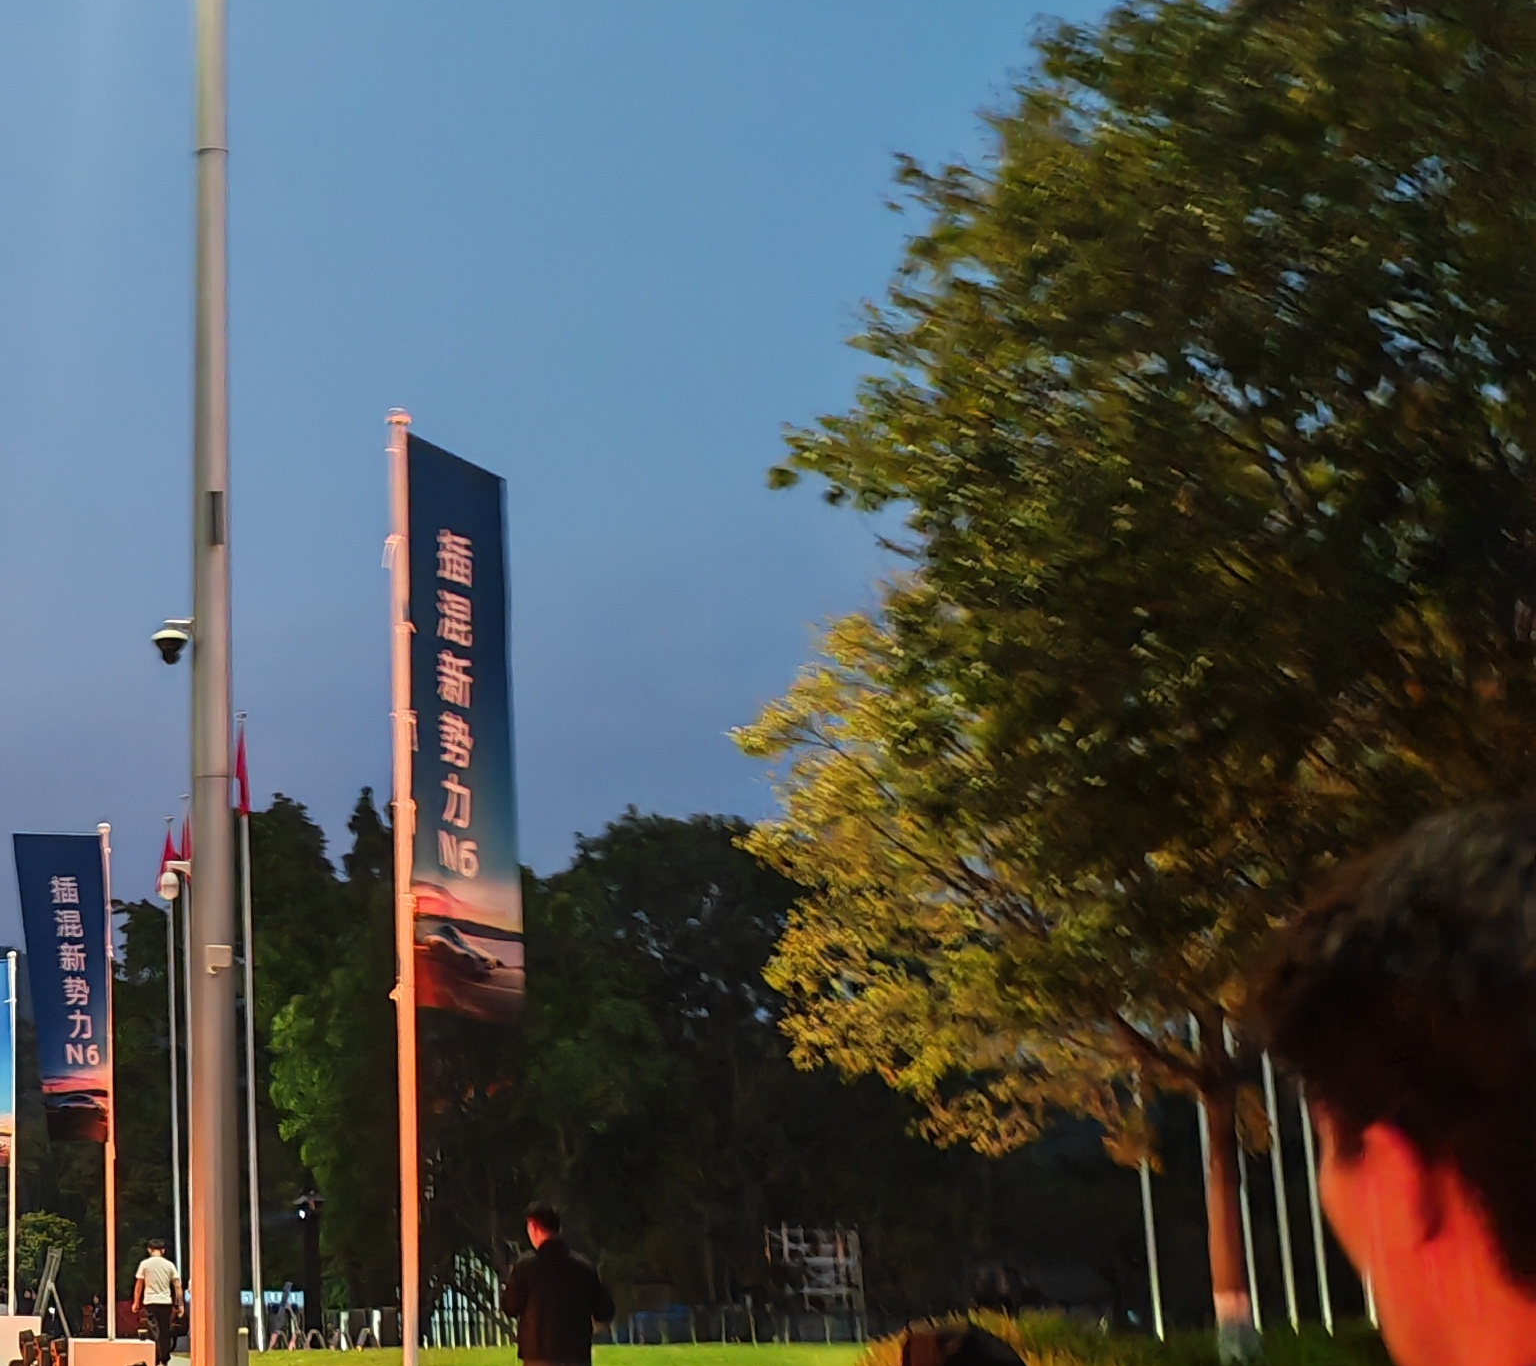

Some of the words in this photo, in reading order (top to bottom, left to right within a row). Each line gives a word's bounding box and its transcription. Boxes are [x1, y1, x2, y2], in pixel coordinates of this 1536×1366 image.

[49, 875, 93, 1040] 插混新势力
[65, 1043, 101, 1067] N6
